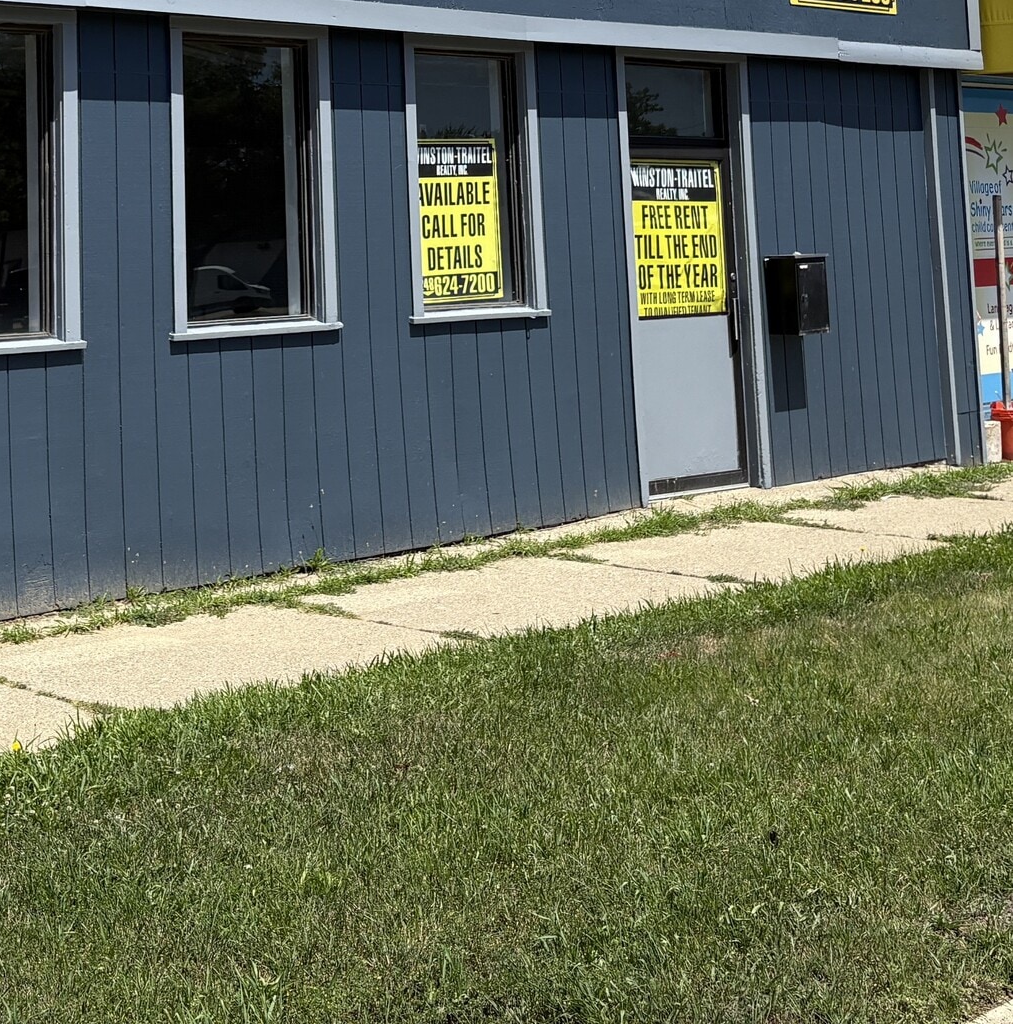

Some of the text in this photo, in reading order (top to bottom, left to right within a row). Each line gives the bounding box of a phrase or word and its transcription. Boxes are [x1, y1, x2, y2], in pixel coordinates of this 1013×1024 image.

[418, 147, 492, 165] INSTON-TRAITEL
[630, 166, 714, 188] WINSTON-TRAITEL
[970, 180, 1002, 196] Village of
[642, 205, 708, 229] FREE RENT
[970, 199, 991, 221] Shiny
[422, 213, 485, 239] CALL FOR
[427, 244, 482, 271] DETAILS
[635, 235, 717, 259] TILL THE END
[423, 277, 434, 291] 48
[638, 264, 718, 290] OF THE YEAR
[640, 290, 715, 305] WITH LONG TERM LEASE
[644, 305, 712, 316] TO QUALIFIED TENANT
[986, 344, 998, 356] Fun
